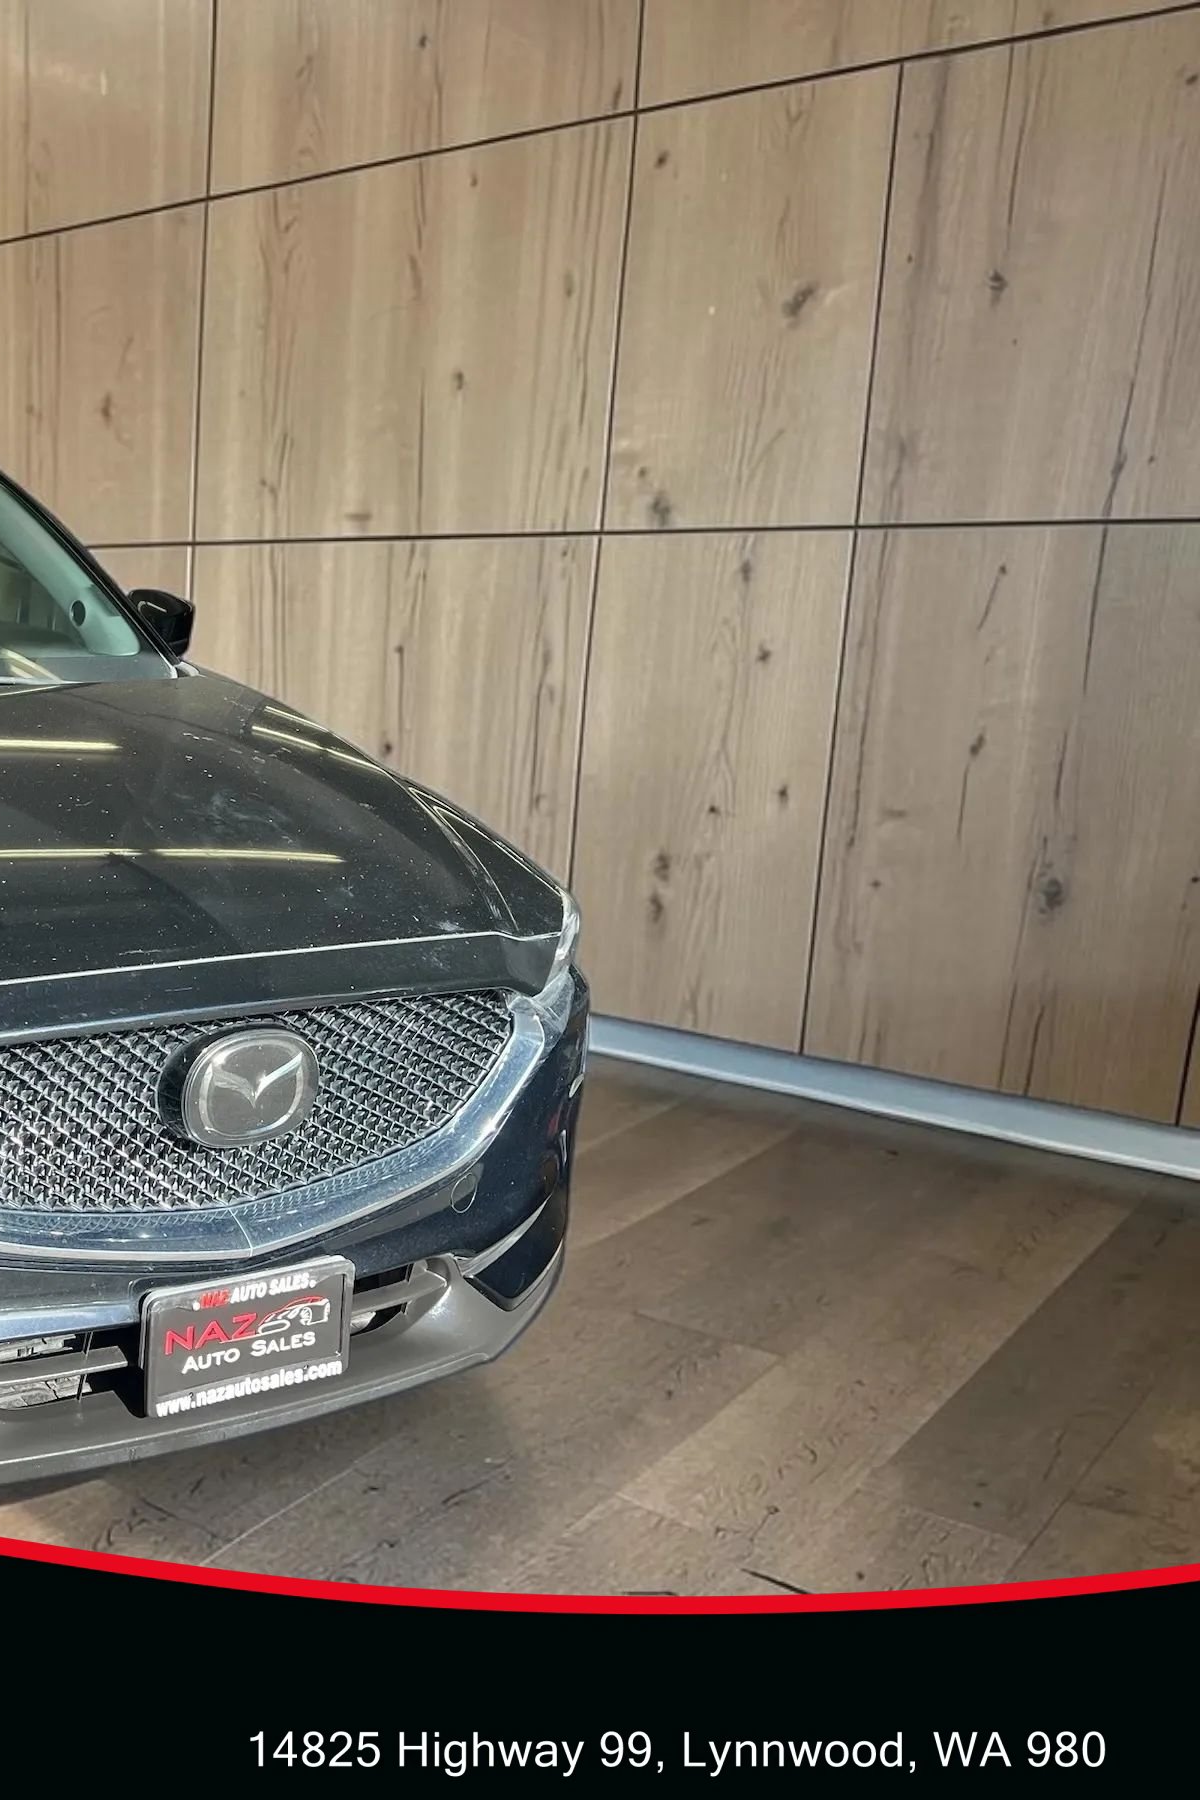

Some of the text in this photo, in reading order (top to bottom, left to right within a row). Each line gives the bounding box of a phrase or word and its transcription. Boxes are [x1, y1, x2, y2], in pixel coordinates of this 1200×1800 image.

[230, 1281, 268, 1304] AUTO
[268, 1272, 310, 1296] SALES
[164, 1312, 258, 1356] NAZ
[181, 1331, 316, 1375] AUTO SALES
[155, 1359, 343, 1418] www.nazautosales.com
